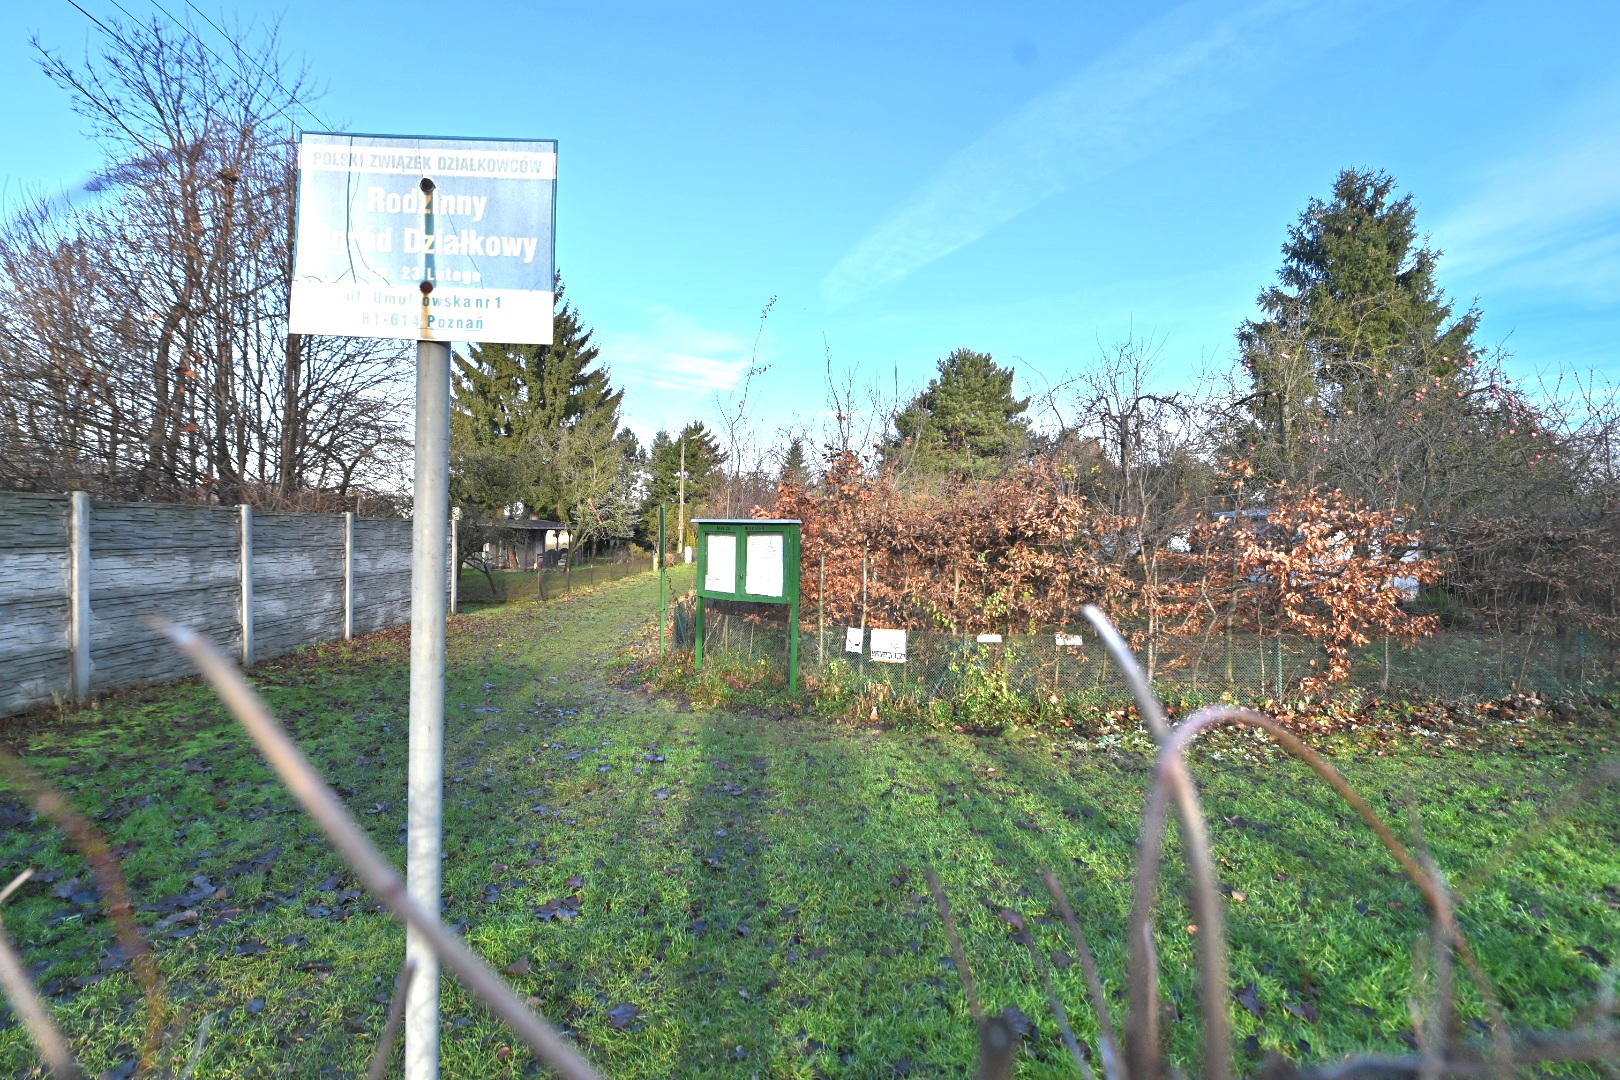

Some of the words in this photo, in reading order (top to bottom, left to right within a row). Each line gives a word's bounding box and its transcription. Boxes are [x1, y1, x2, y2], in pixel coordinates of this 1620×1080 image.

[313, 151, 363, 167] POLSKI
[437, 153, 543, 173] DZIAŁKOWCÓW
[367, 185, 488, 222] Rodzinny
[404, 226, 538, 263] Działkowy
[401, 265, 421, 281] 23
[427, 267, 482, 285] Lutego
[362, 311, 420, 328] 61-614
[426, 314, 484, 330] Poznań
